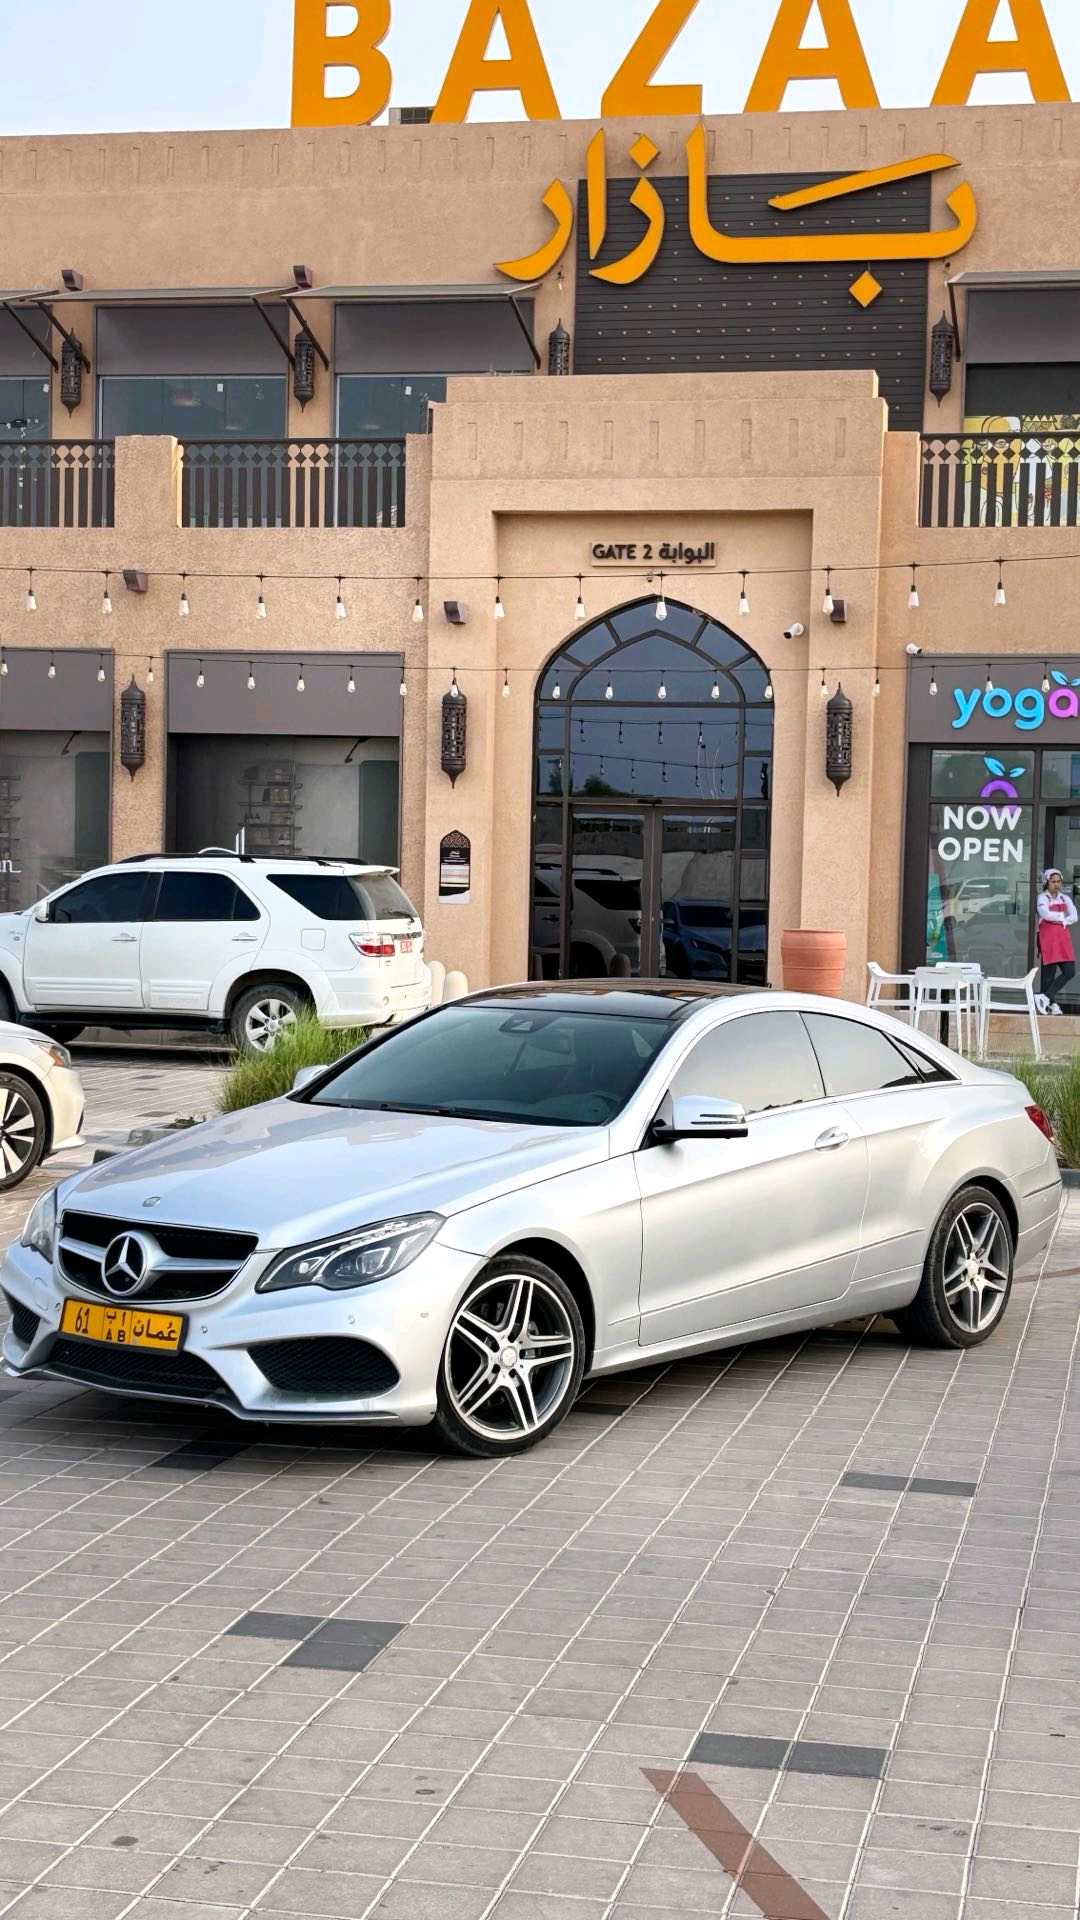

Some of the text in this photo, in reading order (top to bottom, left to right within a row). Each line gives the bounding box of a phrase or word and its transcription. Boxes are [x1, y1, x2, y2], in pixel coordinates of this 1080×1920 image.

[493, 123, 978, 308] بازار
[592, 543, 653, 560] GATE 2
[658, 541, 715, 564] البوابة
[943, 805, 1023, 832] NOW
[937, 837, 1024, 863] OPEN
[74, 1306, 91, 1334] 61
